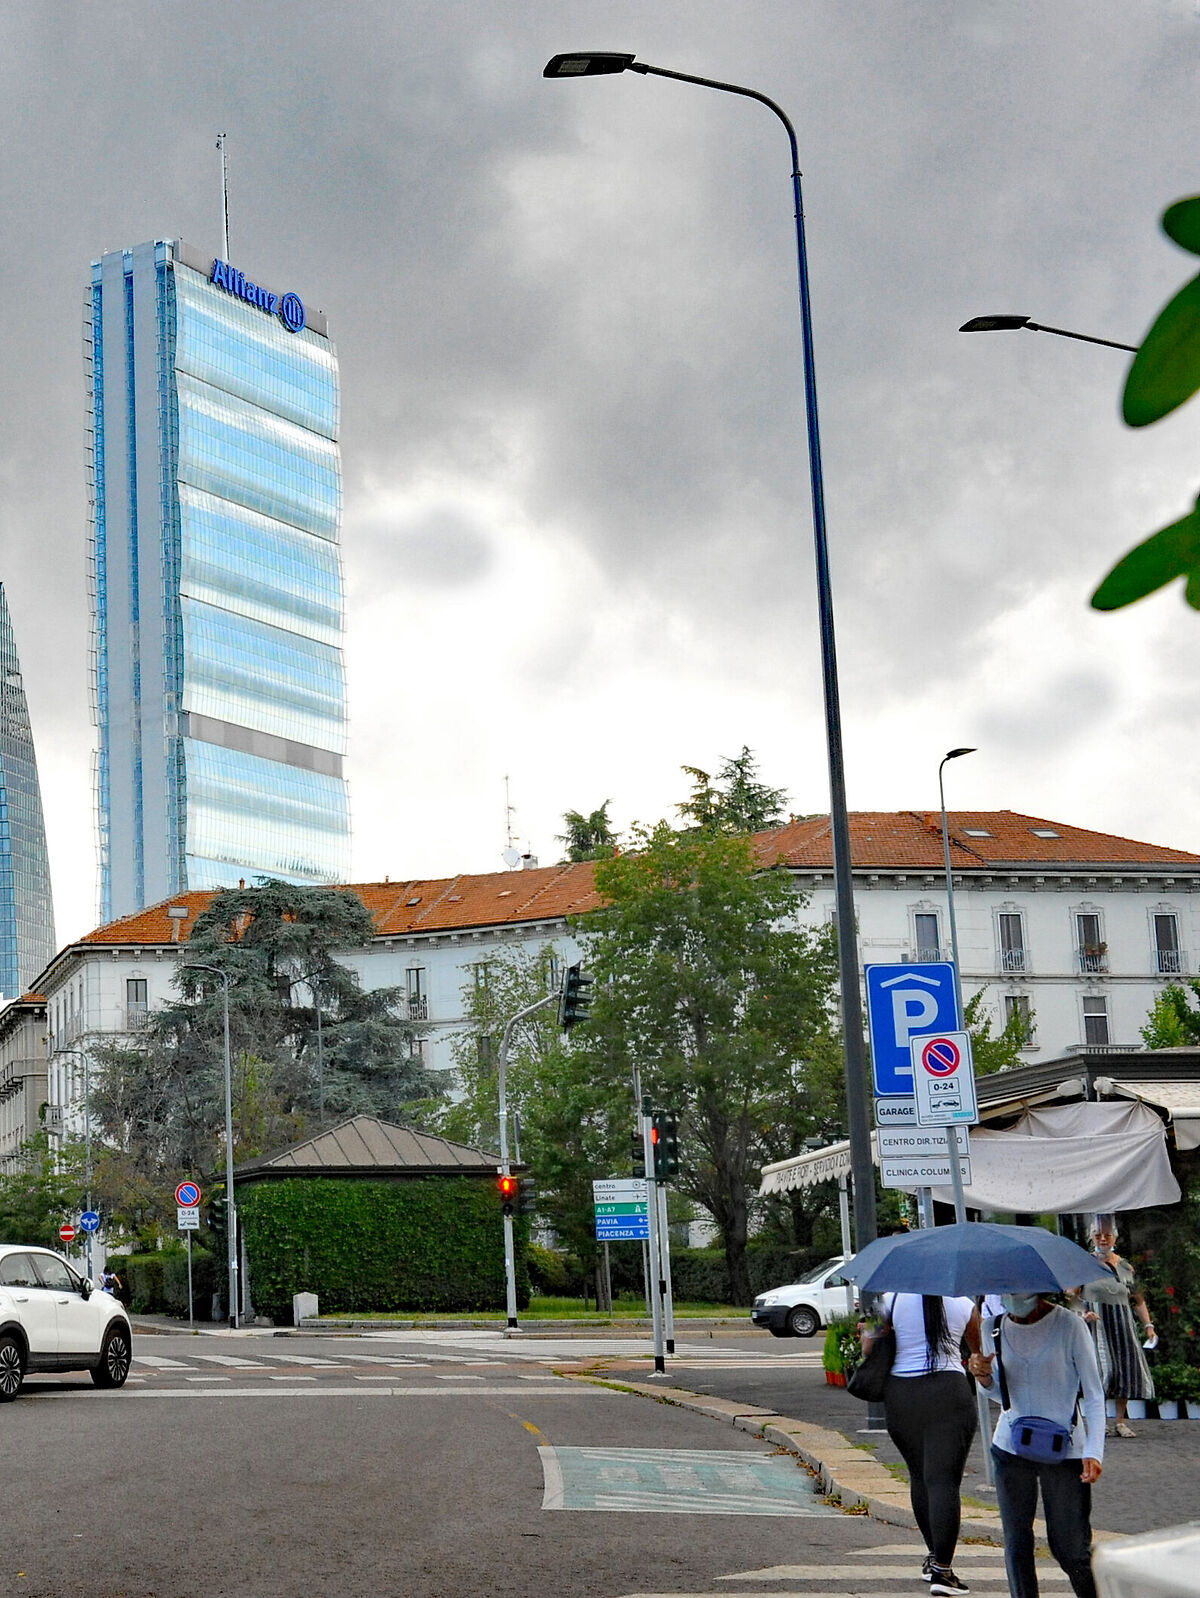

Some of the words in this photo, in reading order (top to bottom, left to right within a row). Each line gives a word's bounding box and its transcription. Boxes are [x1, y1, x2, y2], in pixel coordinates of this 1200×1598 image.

[212, 258, 279, 314] Allianz
[891, 989, 938, 1047] P
[882, 1138, 915, 1146] CENTRO
